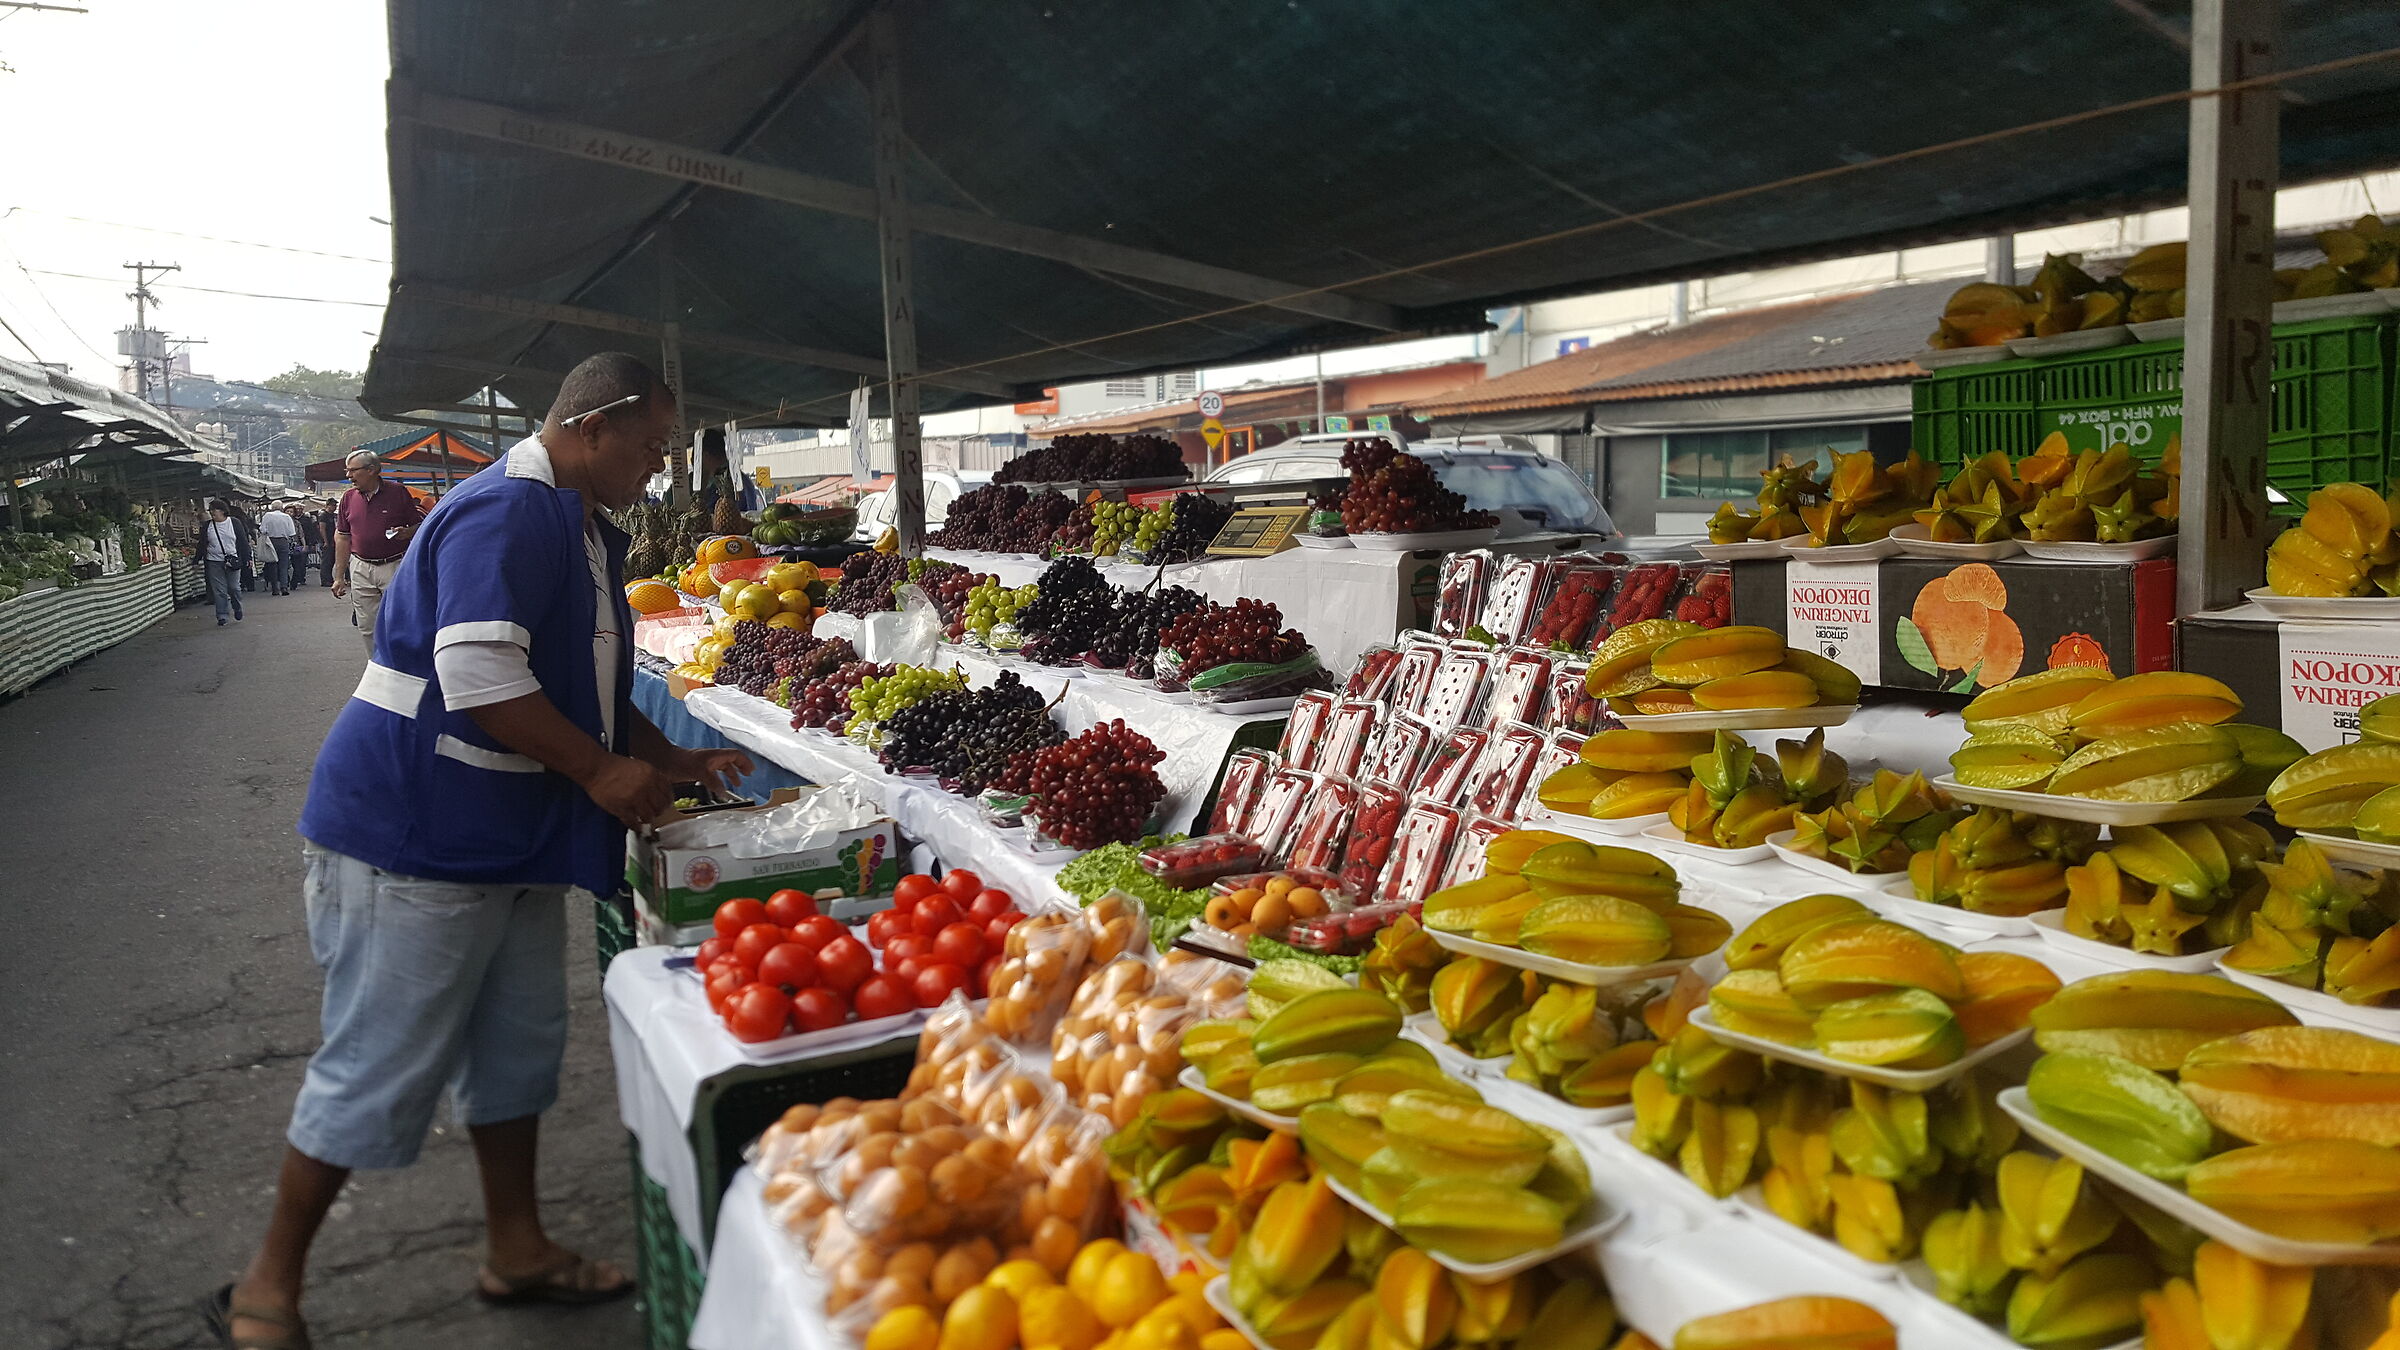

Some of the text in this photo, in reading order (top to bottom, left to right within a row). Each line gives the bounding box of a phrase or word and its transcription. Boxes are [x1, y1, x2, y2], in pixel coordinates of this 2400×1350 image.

[667, 155, 744, 187] PINHO
[2219, 38, 2271, 541] FERN
[1202, 396, 1220, 409] 20
[2058, 412, 2076, 425] 44
[2078, 409, 2111, 424] BOX
[672, 447, 684, 489] PINHO
[1793, 588, 1871, 605] DEKOPON
[1793, 607, 1871, 623] TANGERINA
[2291, 685, 2390, 707] GERINA
